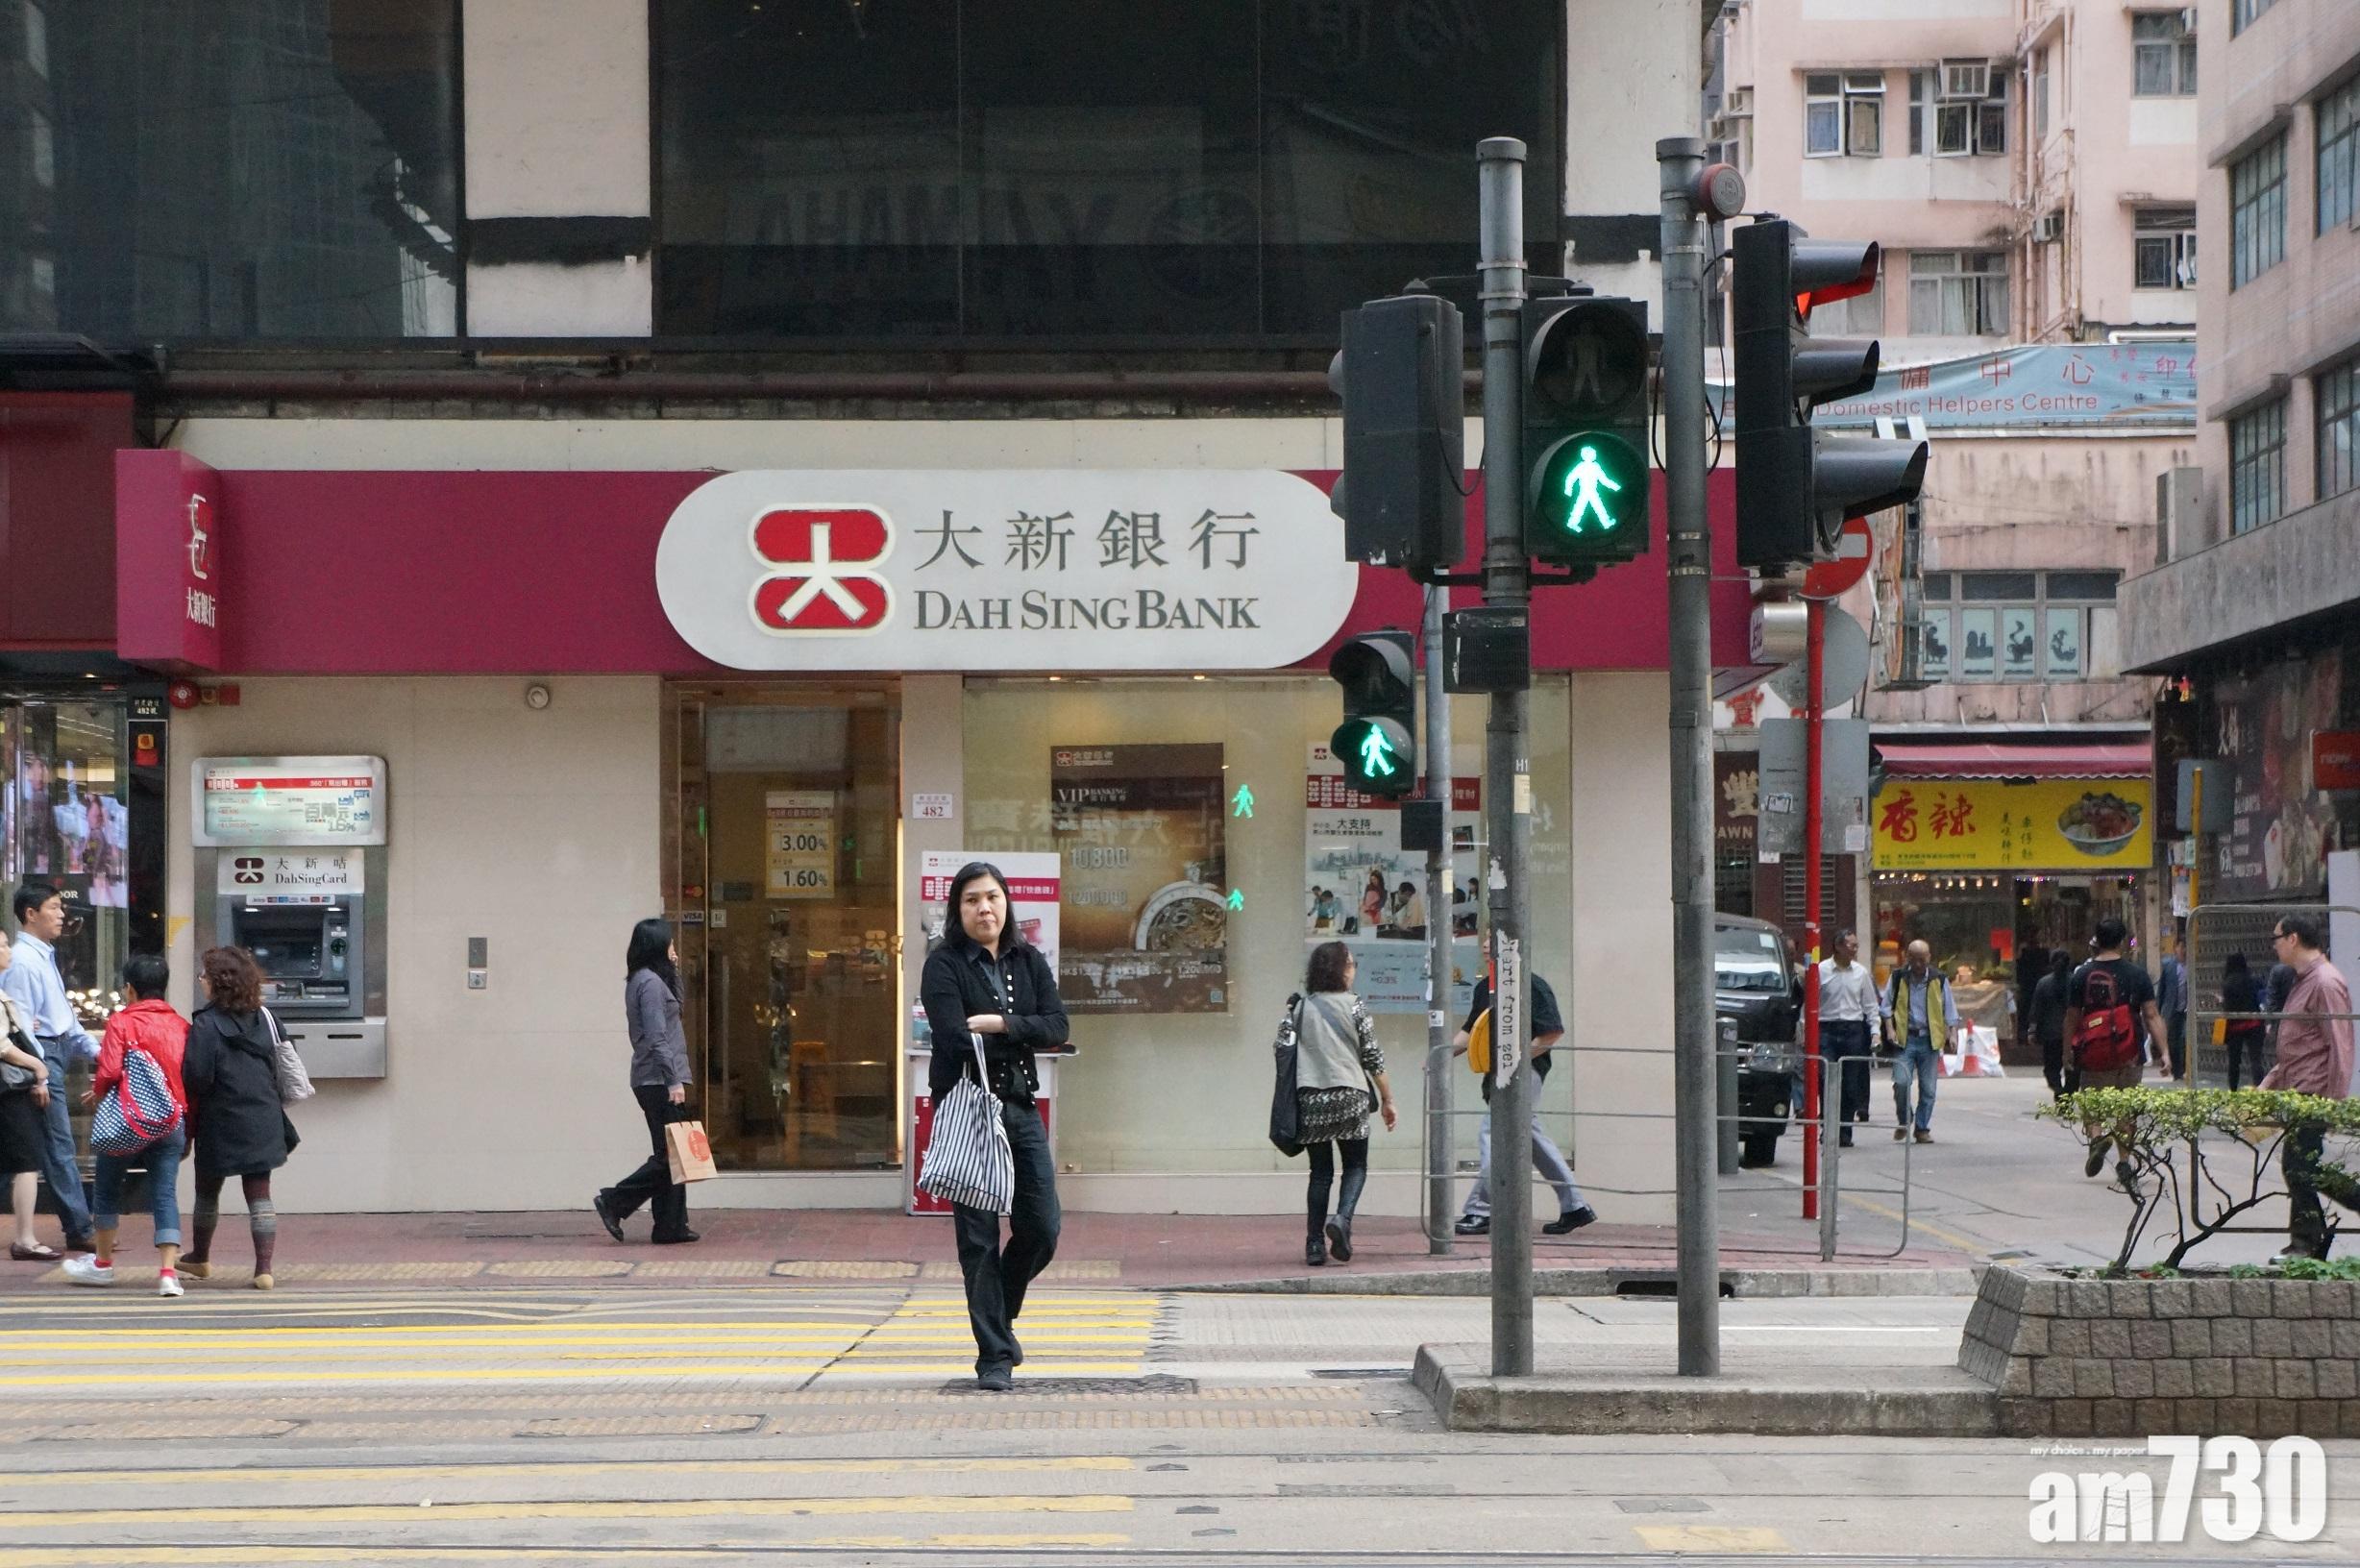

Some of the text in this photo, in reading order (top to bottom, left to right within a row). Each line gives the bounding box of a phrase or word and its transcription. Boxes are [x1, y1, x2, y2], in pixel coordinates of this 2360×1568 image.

[1816, 390, 2098, 416] Domestic Helpers Centre
[914, 508, 1261, 572] 大新銀行
[186, 587, 216, 628] 大新銀行
[914, 589, 1261, 631] DAH SING BANK
[1058, 788, 1090, 802] VIP
[922, 806, 944, 817] 482
[1337, 817, 1371, 830] 大支持
[1880, 790, 1976, 843] 香辣
[1714, 825, 1754, 839] AWN
[275, 872, 347, 886] DahSingCard
[1502, 995, 1515, 1036] from
